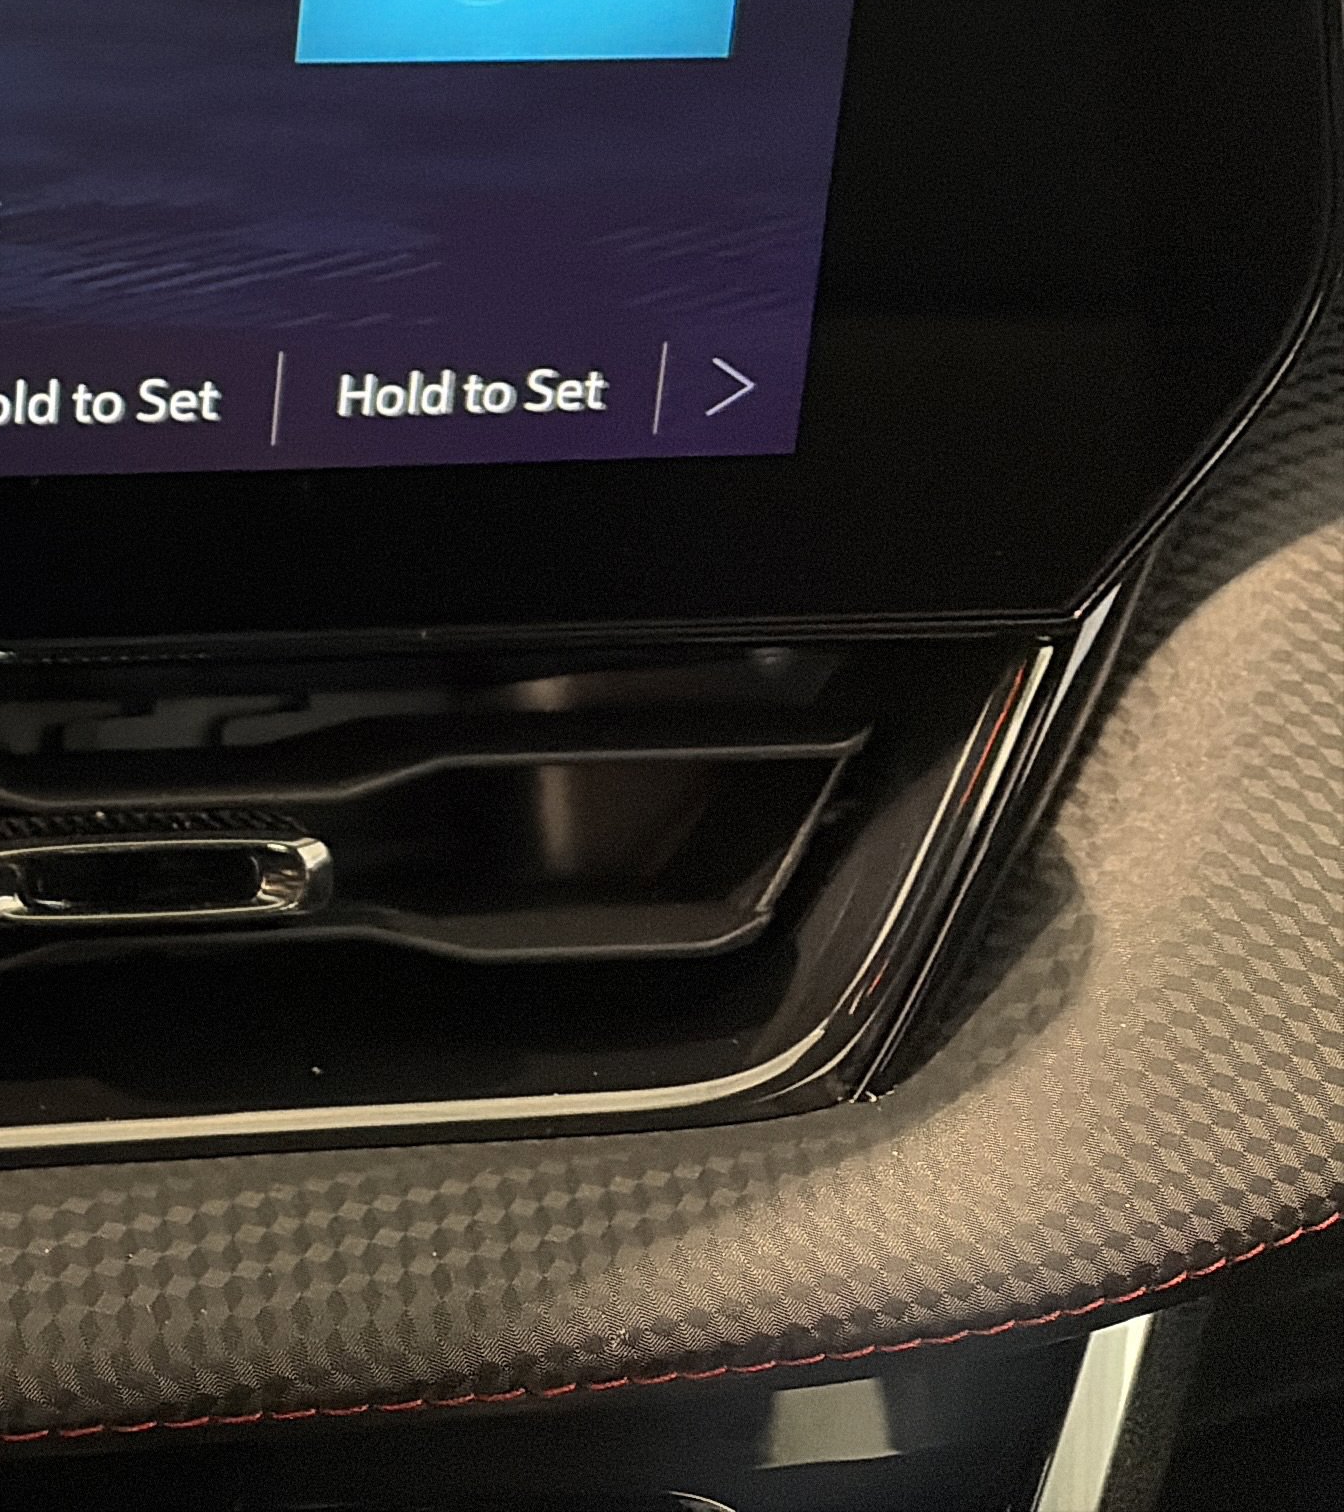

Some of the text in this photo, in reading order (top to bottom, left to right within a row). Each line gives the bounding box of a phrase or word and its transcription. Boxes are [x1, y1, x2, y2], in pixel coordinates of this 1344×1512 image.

[70, 382, 126, 425] to
[134, 377, 223, 424] Set
[336, 367, 610, 418] Hold to Set
